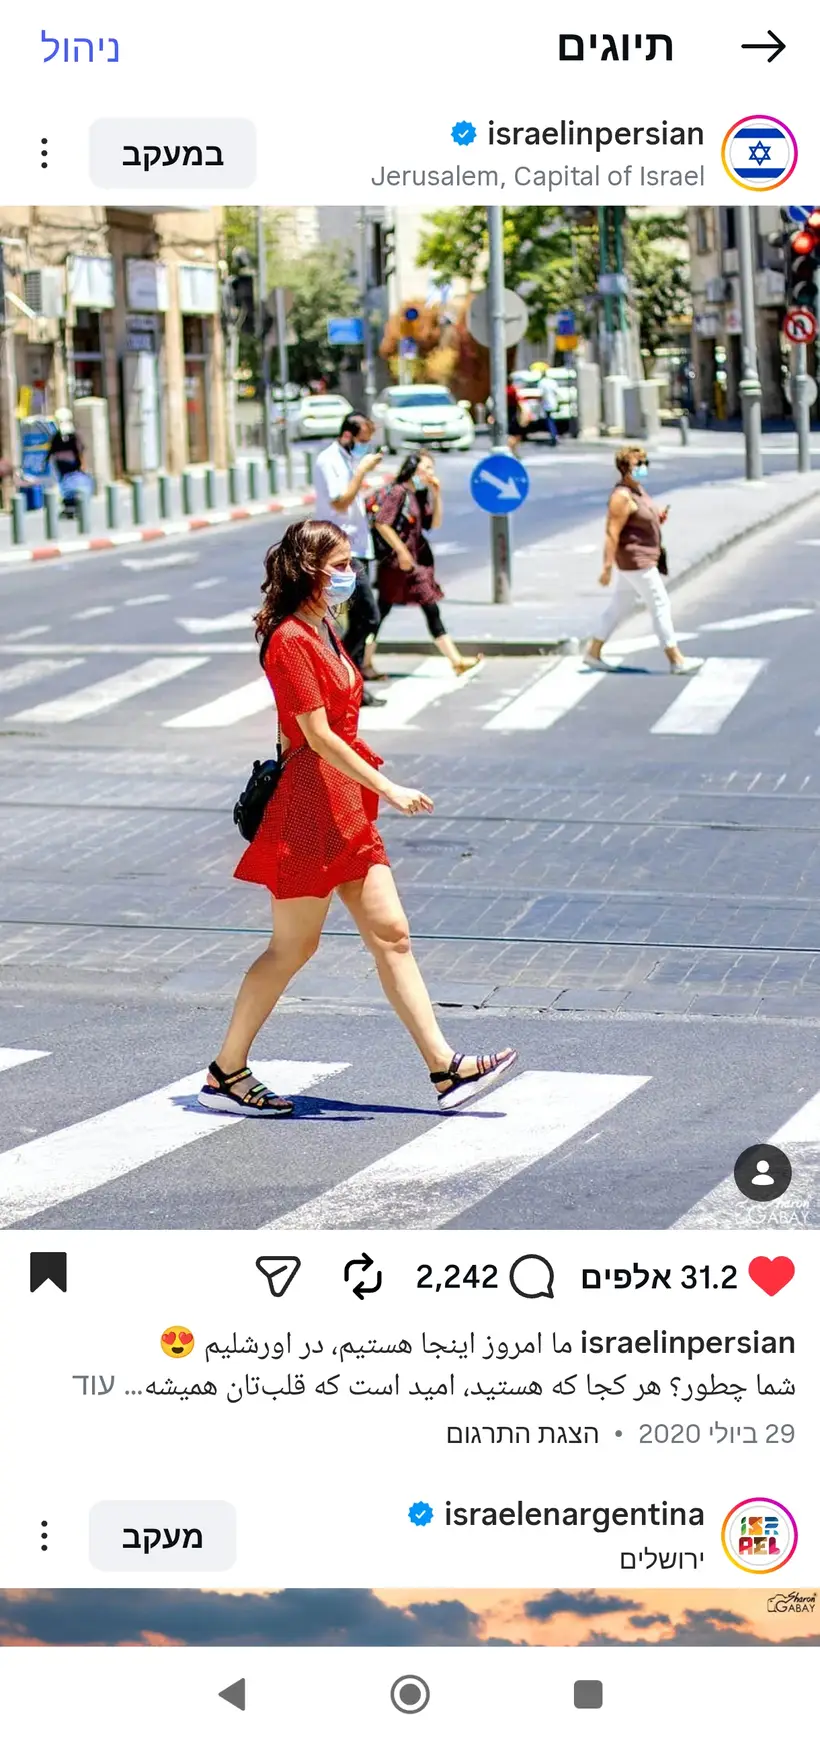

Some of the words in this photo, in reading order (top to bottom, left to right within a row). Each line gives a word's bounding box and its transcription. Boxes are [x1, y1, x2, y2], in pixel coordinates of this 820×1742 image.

[41, 30, 119, 63] ניהול
[558, 33, 673, 62] תיוגים
[488, 119, 704, 153] israelinpersian
[122, 145, 225, 173] במעקב
[371, 164, 506, 190] Jerusalem,
[514, 164, 600, 193] Capital
[607, 164, 633, 187] of
[640, 164, 704, 187] Israel
[416, 1263, 499, 1293] 2,242
[581, 1261, 672, 1290] אלפים
[680, 1264, 738, 1290] 31.2
[204, 1331, 292, 1363] اورشلیم
[298, 1339, 324, 1361] در
[331, 1338, 413, 1363] هستیم،
[421, 1331, 475, 1360] اینجا
[481, 1331, 542, 1361] امروز
[552, 1331, 573, 1354] ما
[581, 1329, 795, 1361] israelinpersian
[71, 1375, 115, 1396] עוד
[314, 1373, 341, 1396] که
[348, 1372, 400, 1396] است
[408, 1372, 455, 1402] امید
[463, 1380, 543, 1402] هستید،
[551, 1373, 578, 1396] که
[586, 1373, 627, 1402] کجا
[632, 1380, 662, 1402] هر
[669, 1372, 748, 1403] چطور؟
[756, 1373, 796, 1396] شما
[447, 1426, 530, 1444] התרגום
[537, 1426, 599, 1444] הצגת
[639, 1423, 701, 1444] 2020
[709, 1420, 758, 1444] ביולי
[765, 1423, 795, 1444] 29
[445, 1500, 704, 1534] israelenargentina
[122, 1527, 203, 1555] מעקב
[620, 1546, 704, 1570] ירושלים
